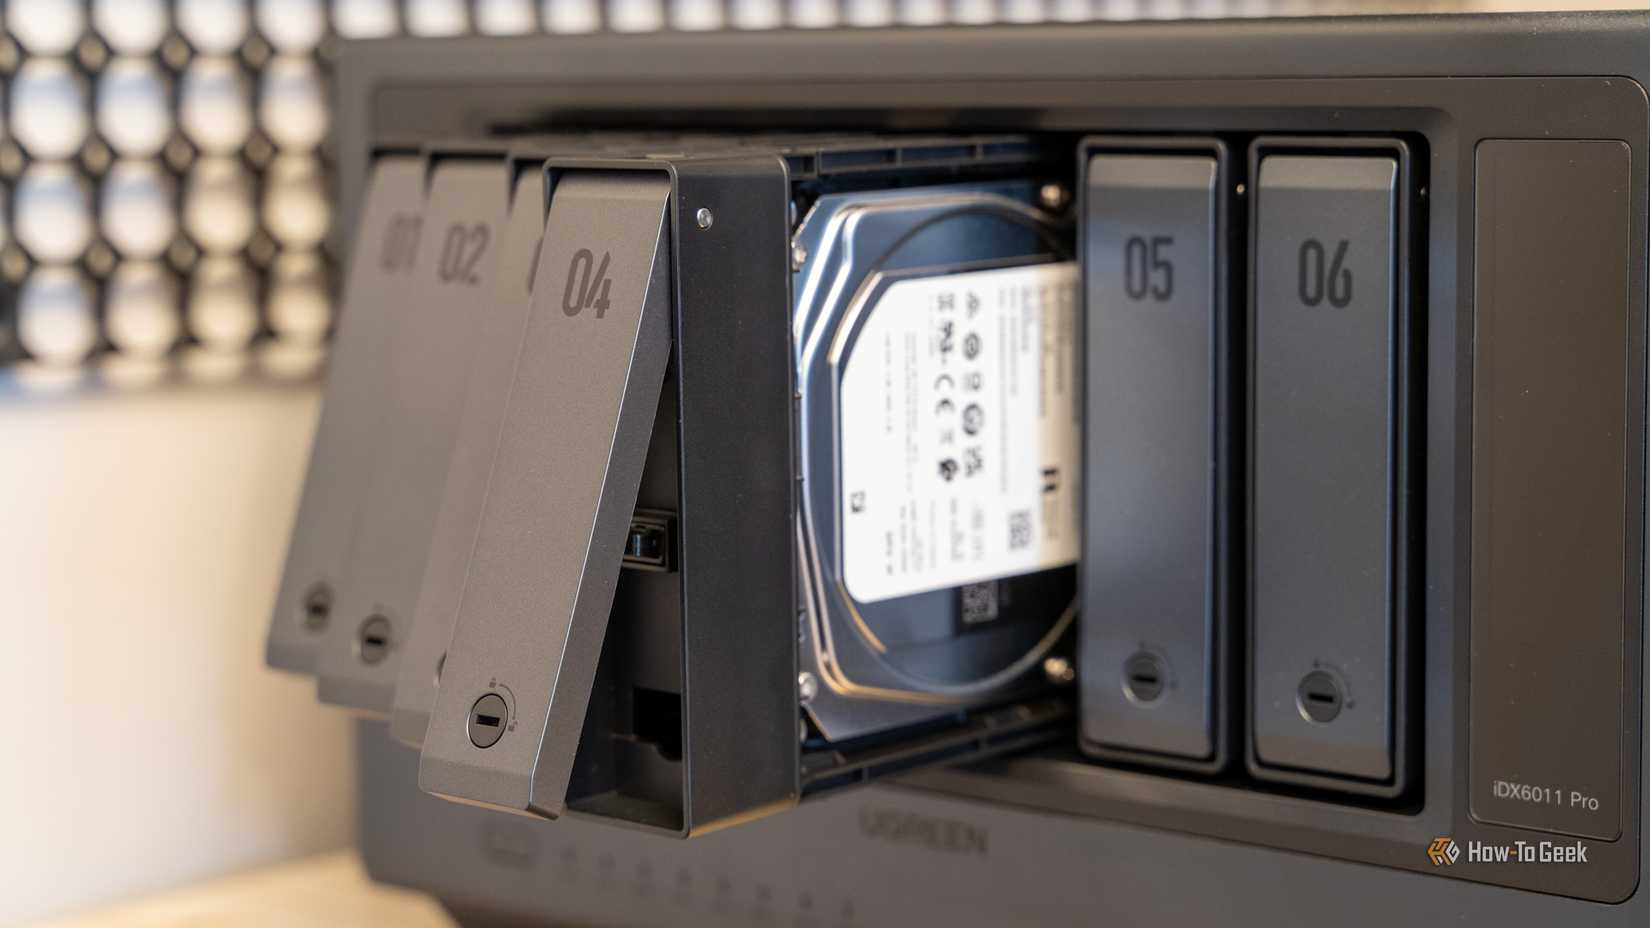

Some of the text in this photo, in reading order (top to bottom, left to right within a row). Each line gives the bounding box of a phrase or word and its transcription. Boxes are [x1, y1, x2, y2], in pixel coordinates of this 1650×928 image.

[438, 223, 490, 284] 02
[562, 248, 612, 318] 04
[1124, 235, 1174, 301] 05
[1299, 238, 1352, 309] 06
[1493, 780, 1600, 811] iDX6011 Pro
